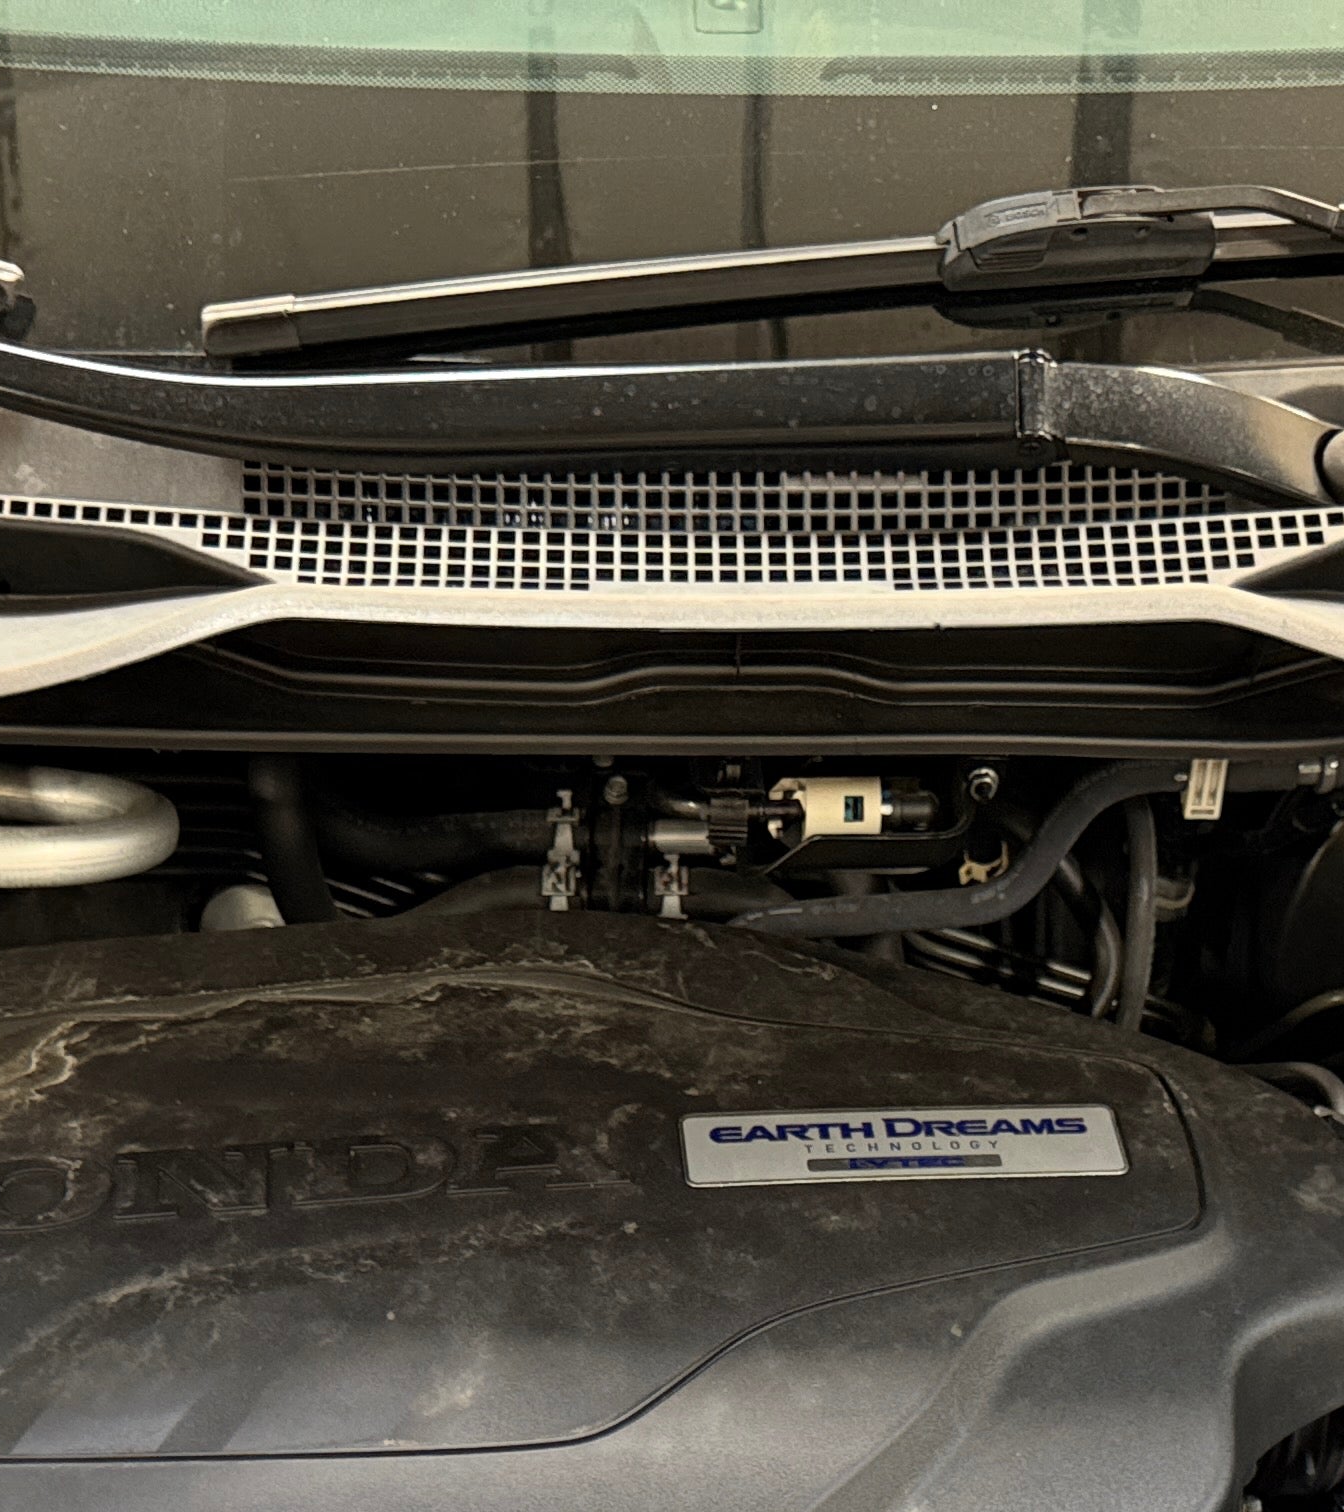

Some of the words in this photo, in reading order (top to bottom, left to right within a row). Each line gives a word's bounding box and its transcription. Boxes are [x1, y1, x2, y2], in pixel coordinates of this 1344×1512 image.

[709, 1121, 875, 1143] EARTH
[883, 1117, 1087, 1139] DREAMS
[804, 1140, 999, 1154] TECHNOLOGY
